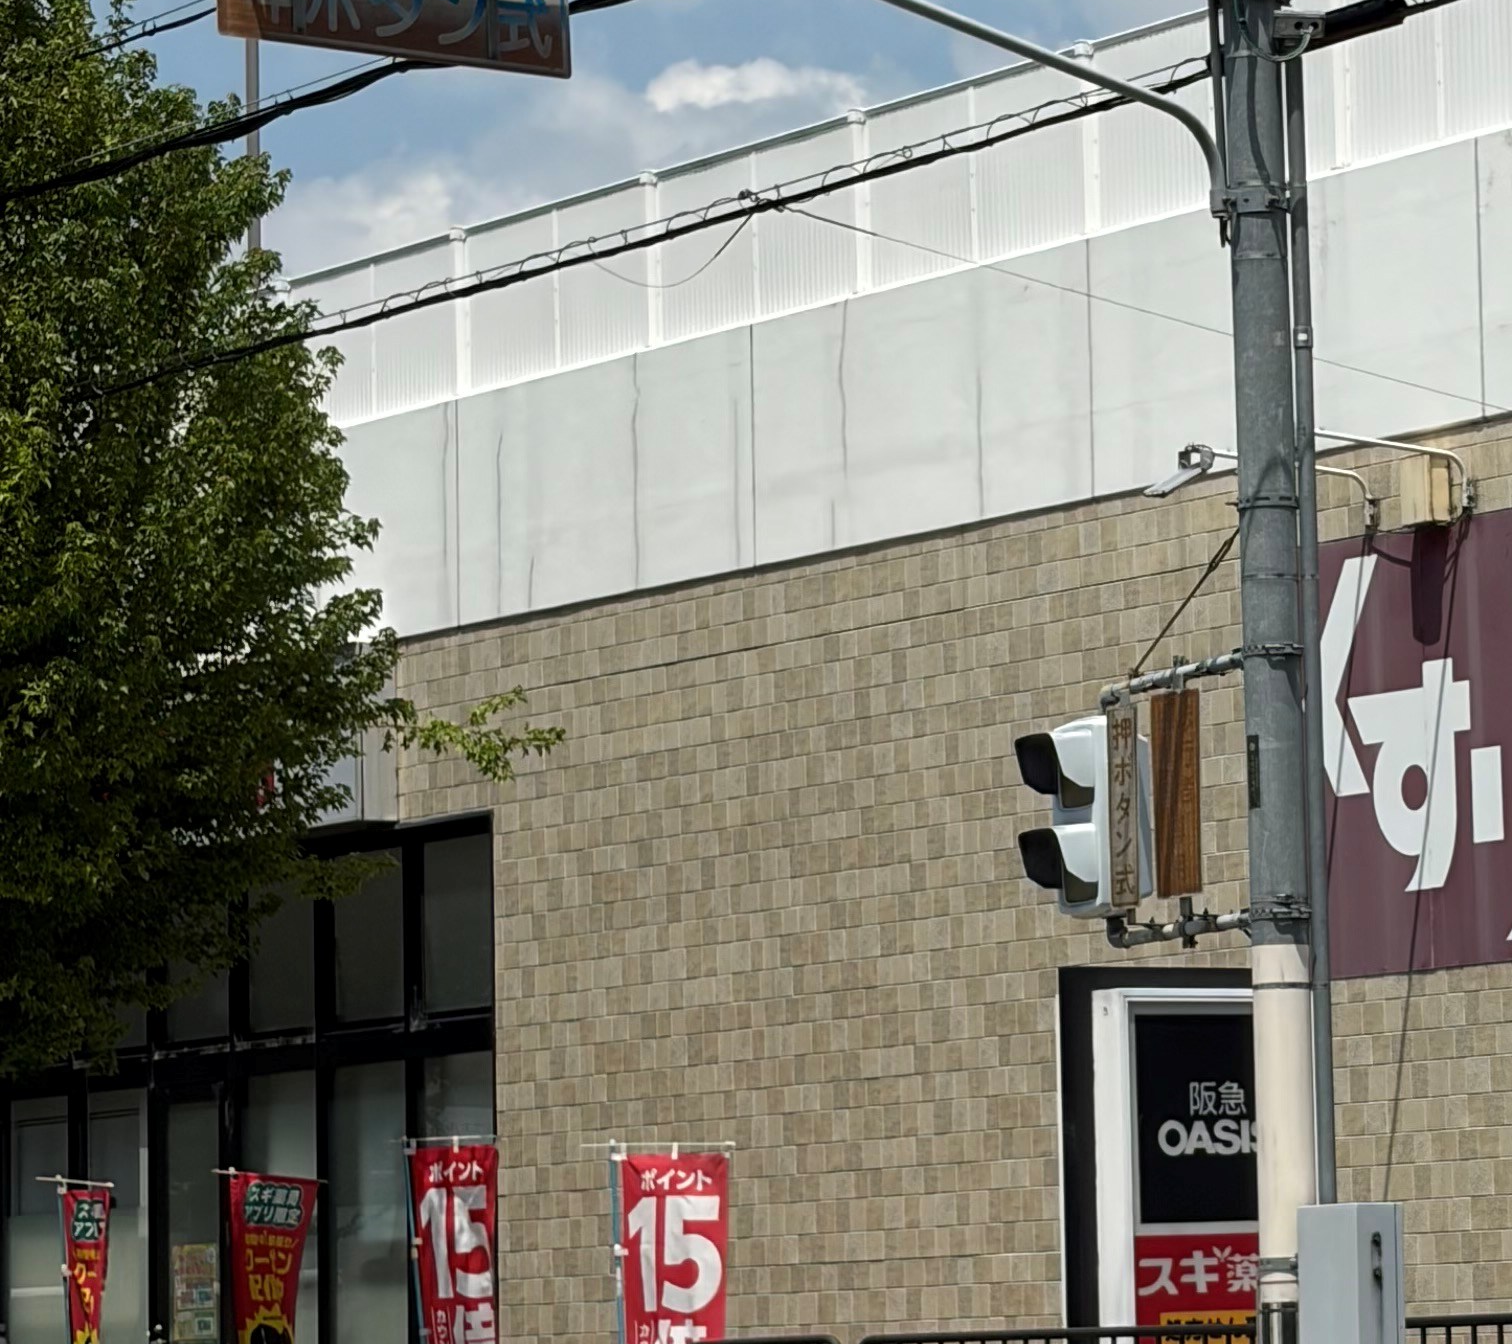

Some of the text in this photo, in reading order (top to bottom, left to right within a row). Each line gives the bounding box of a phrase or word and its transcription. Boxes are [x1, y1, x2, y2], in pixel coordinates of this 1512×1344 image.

[1112, 718, 1136, 895] 押ボタン式
[1189, 1080, 1248, 1117] 阪急
[1158, 1119, 1258, 1156] OASI
[429, 1161, 484, 1183] ポイント
[639, 1169, 713, 1190] ポイント
[420, 1185, 493, 1299] 15
[628, 1195, 723, 1314] 15
